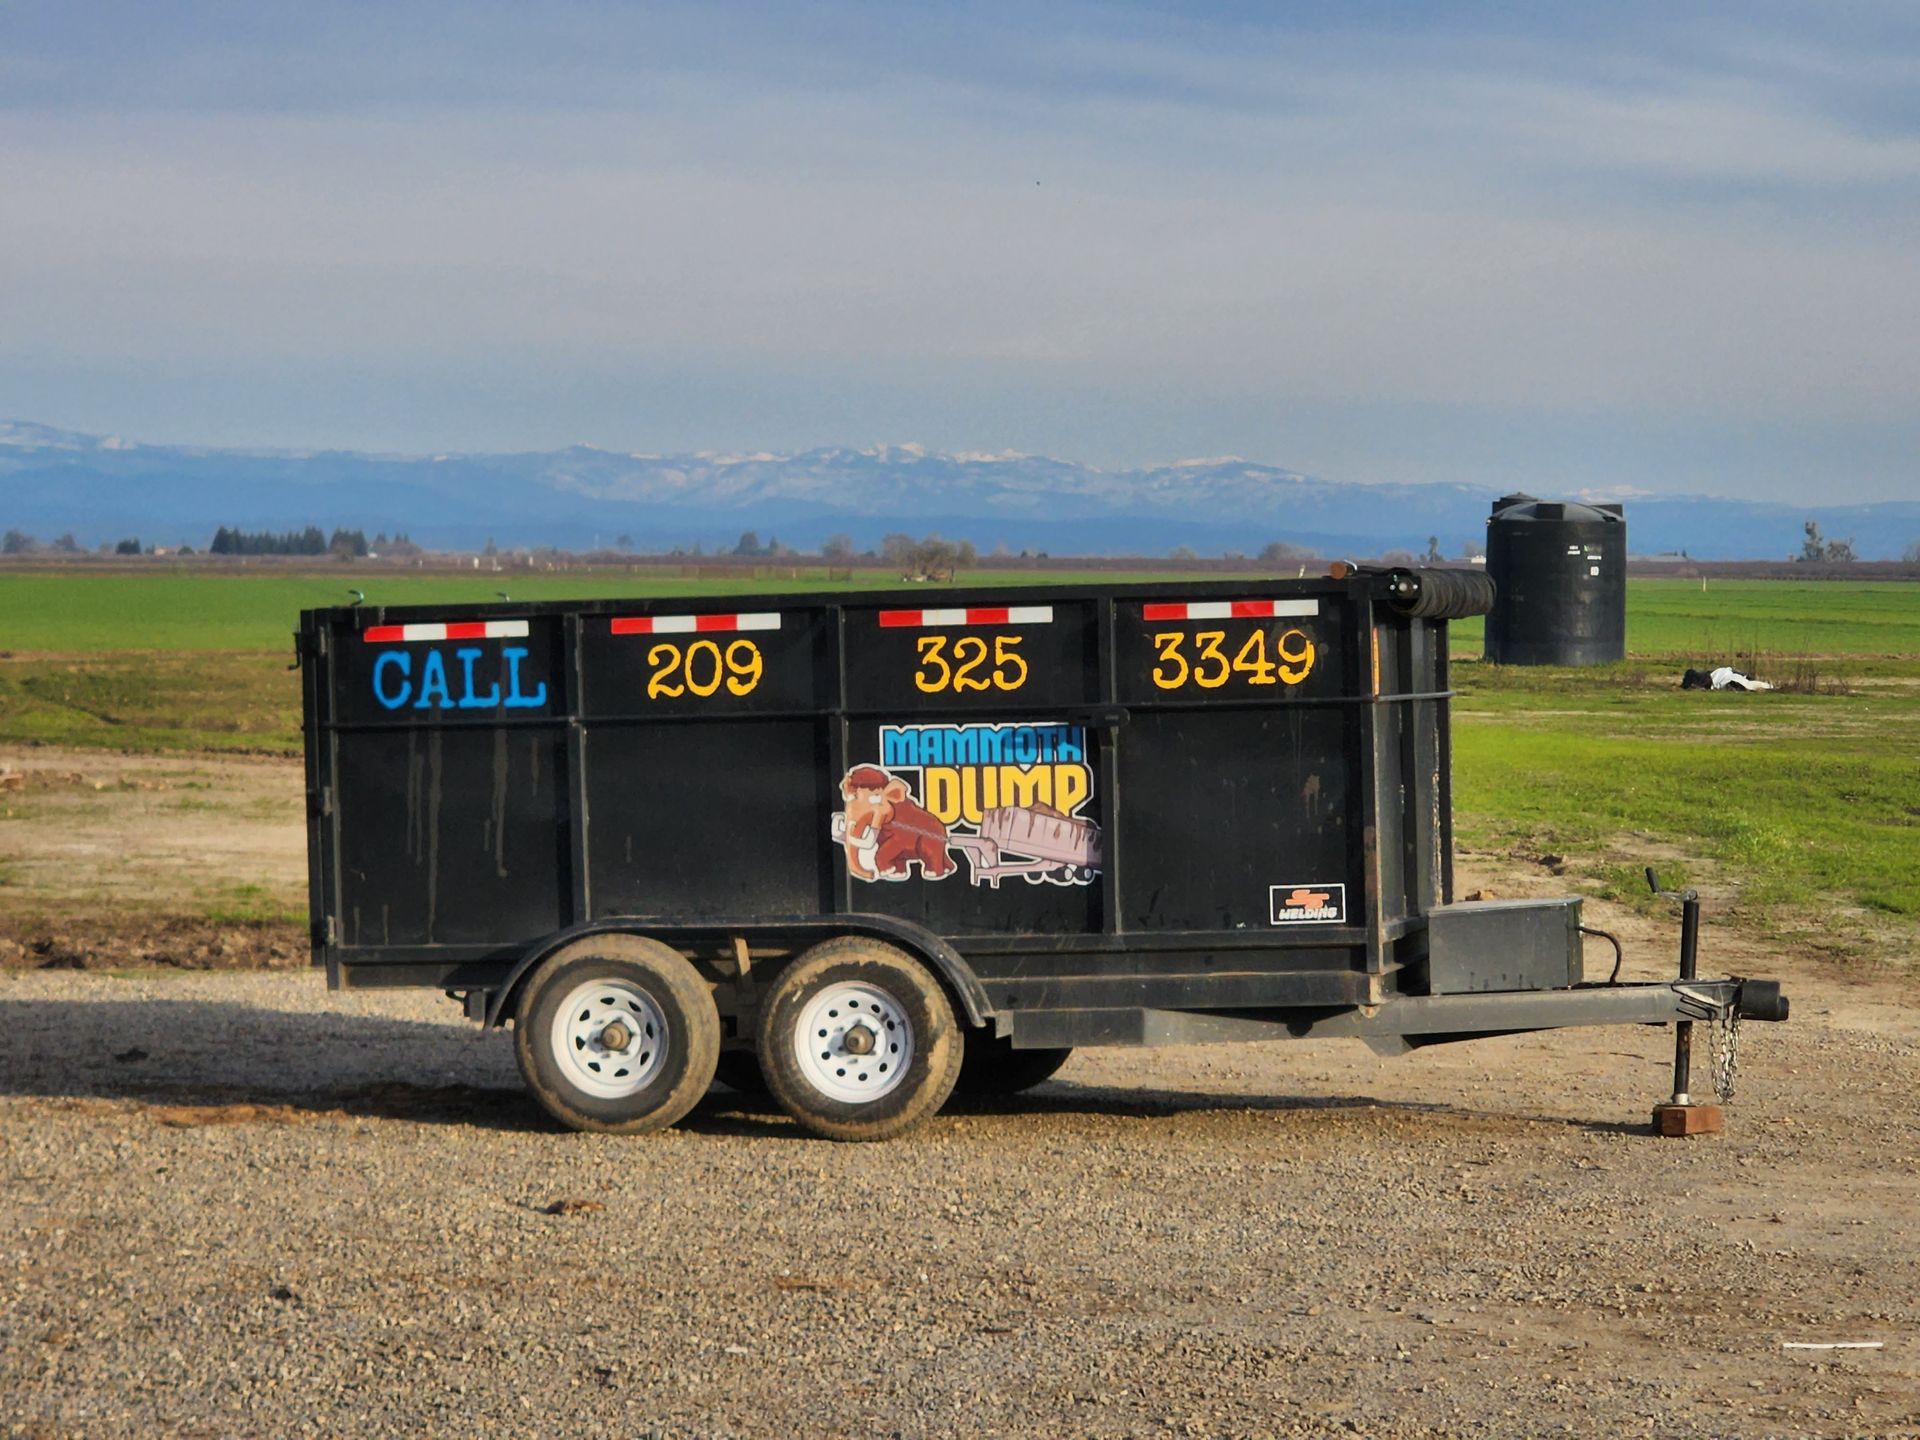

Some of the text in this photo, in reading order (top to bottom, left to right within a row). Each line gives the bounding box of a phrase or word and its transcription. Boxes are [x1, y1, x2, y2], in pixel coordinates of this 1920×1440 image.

[373, 629, 1316, 709] CALL 209 325 3349
[882, 726, 1083, 766] MAMMOTH
[925, 764, 1088, 825] DUMP
[1279, 905, 1338, 920] WELDING
